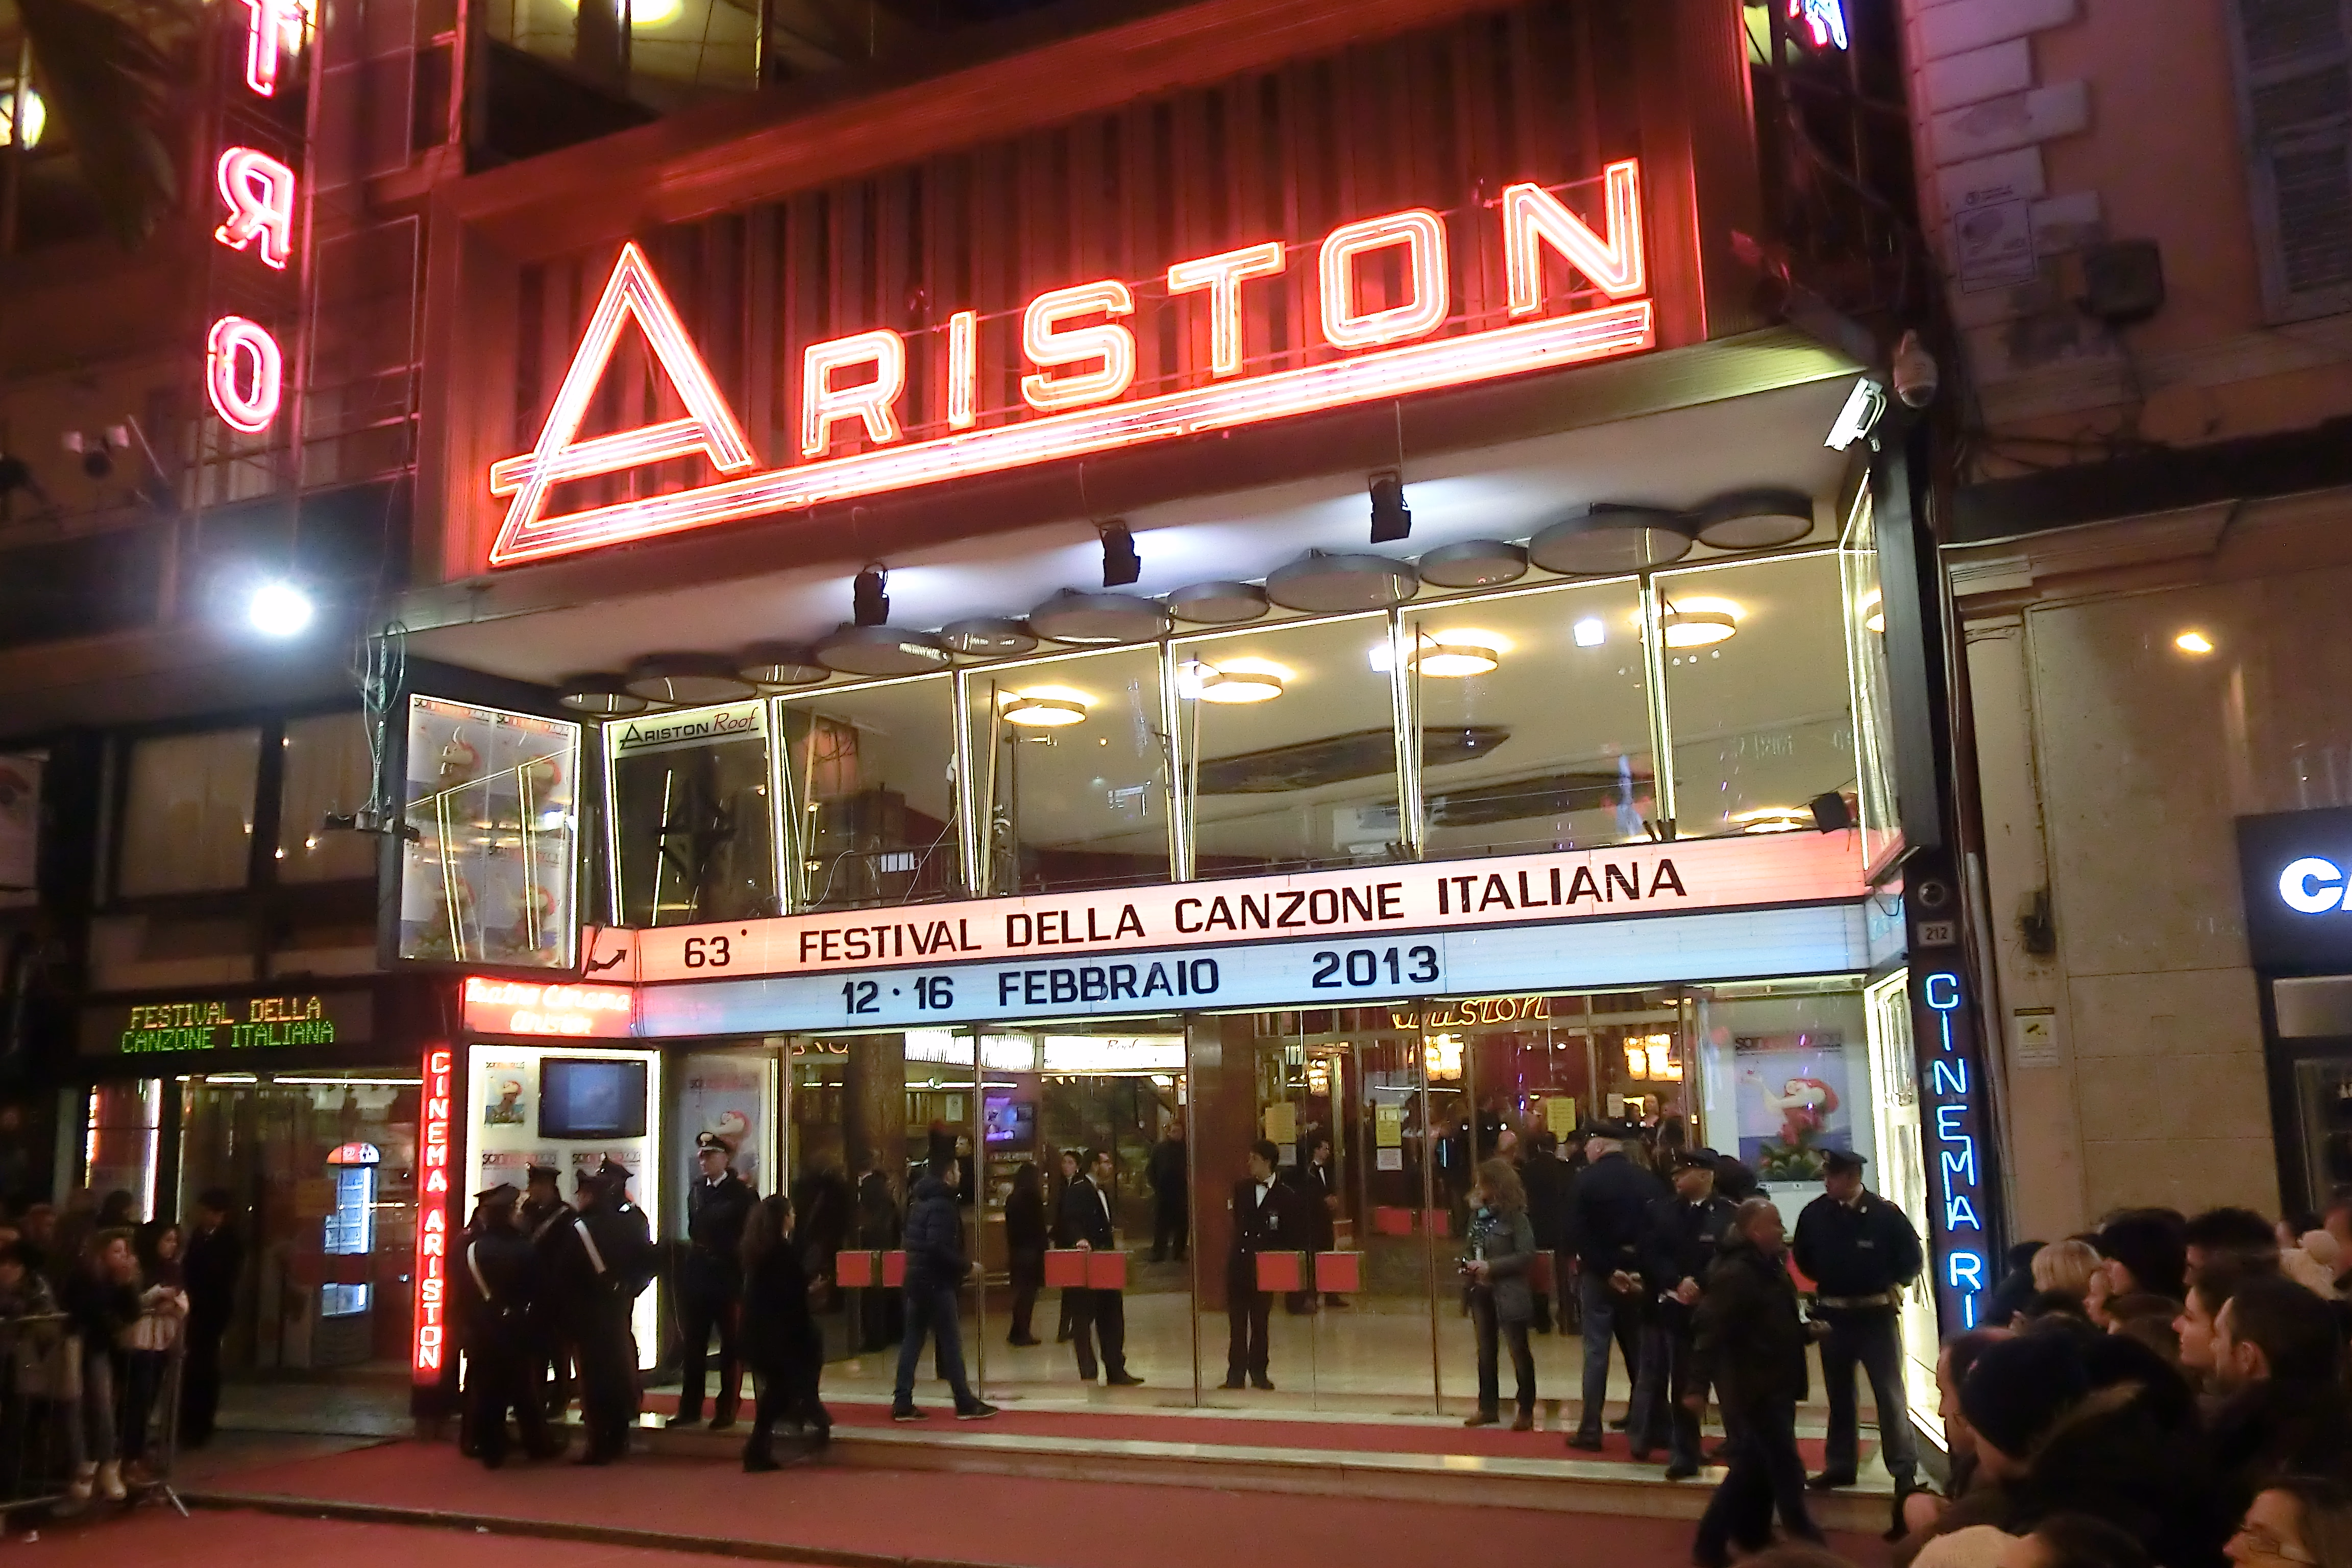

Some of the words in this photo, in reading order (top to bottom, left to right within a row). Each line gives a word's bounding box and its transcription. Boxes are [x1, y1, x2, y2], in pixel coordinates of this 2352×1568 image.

[490, 156, 1655, 567] ARISTON
[619, 722, 708, 751] ARISTON
[714, 706, 758, 733] Roof
[798, 918, 982, 963] FESTIVAL
[1007, 903, 1146, 948] DELLA
[1174, 883, 1404, 933] CANZONE
[1438, 858, 1687, 915] ITALIANA
[2277, 856, 2352, 914] C
[1926, 926, 1948, 940] 212
[998, 958, 1220, 1008] FEBBRAIO
[1311, 945, 1440, 989] 2013
[121, 1025, 216, 1054] CANZONE
[231, 1020, 335, 1048] ITALIANA
[130, 1001, 235, 1030] FESTIVAL
[250, 995, 322, 1022] DELLA
[425, 1051, 451, 1193] CINEMA
[1925, 973, 1981, 1232] CINEMA
[418, 1208, 446, 1370] ARISTON
